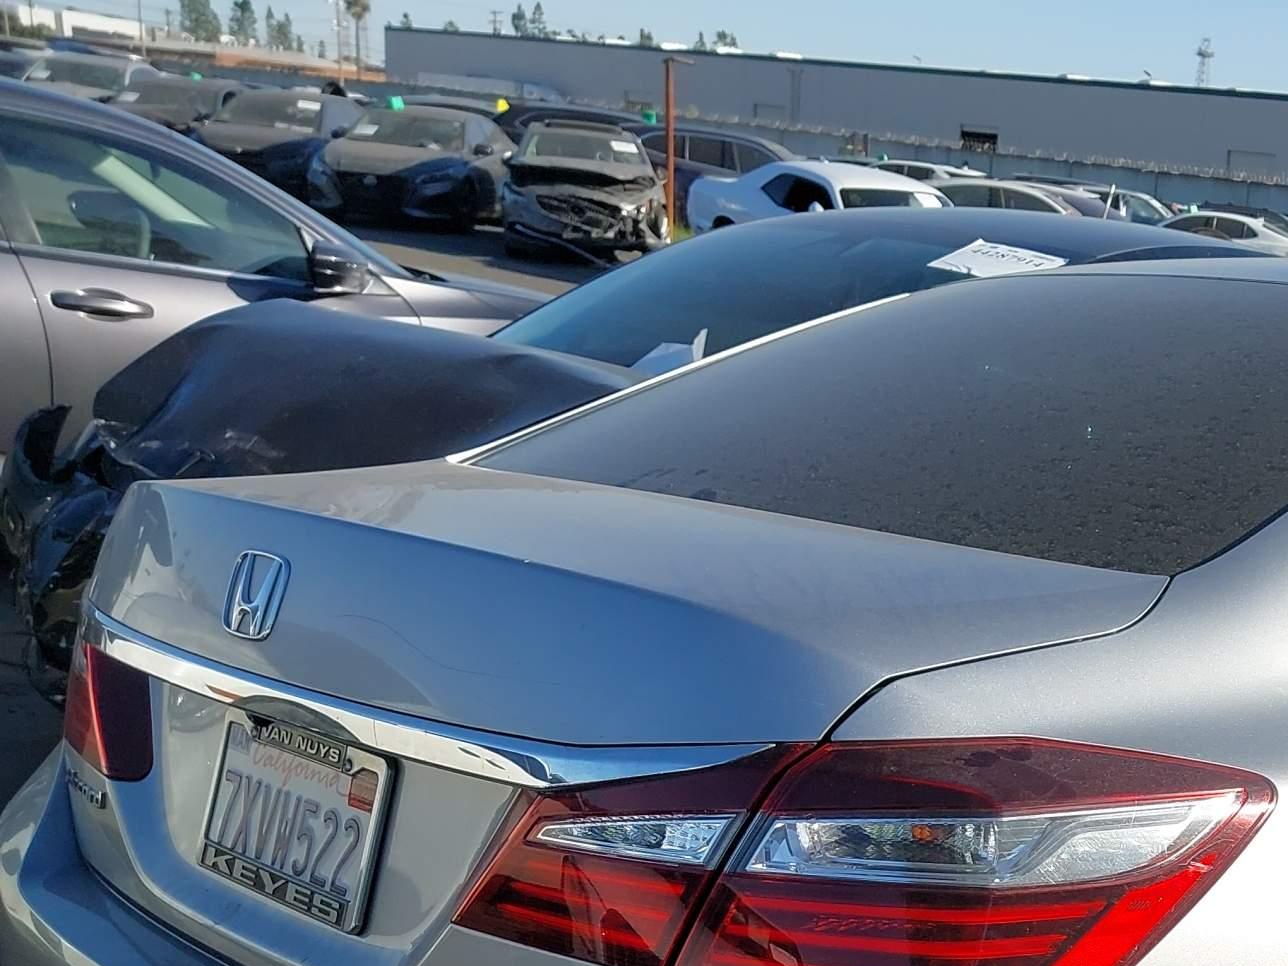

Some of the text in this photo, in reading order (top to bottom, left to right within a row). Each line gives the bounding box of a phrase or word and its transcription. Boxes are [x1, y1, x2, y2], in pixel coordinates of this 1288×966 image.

[252, 744, 346, 794] California
[261, 723, 292, 746] VAN
[295, 735, 342, 763] NUYS
[216, 768, 360, 897] 7XVW522
[206, 849, 342, 925] KEYES
